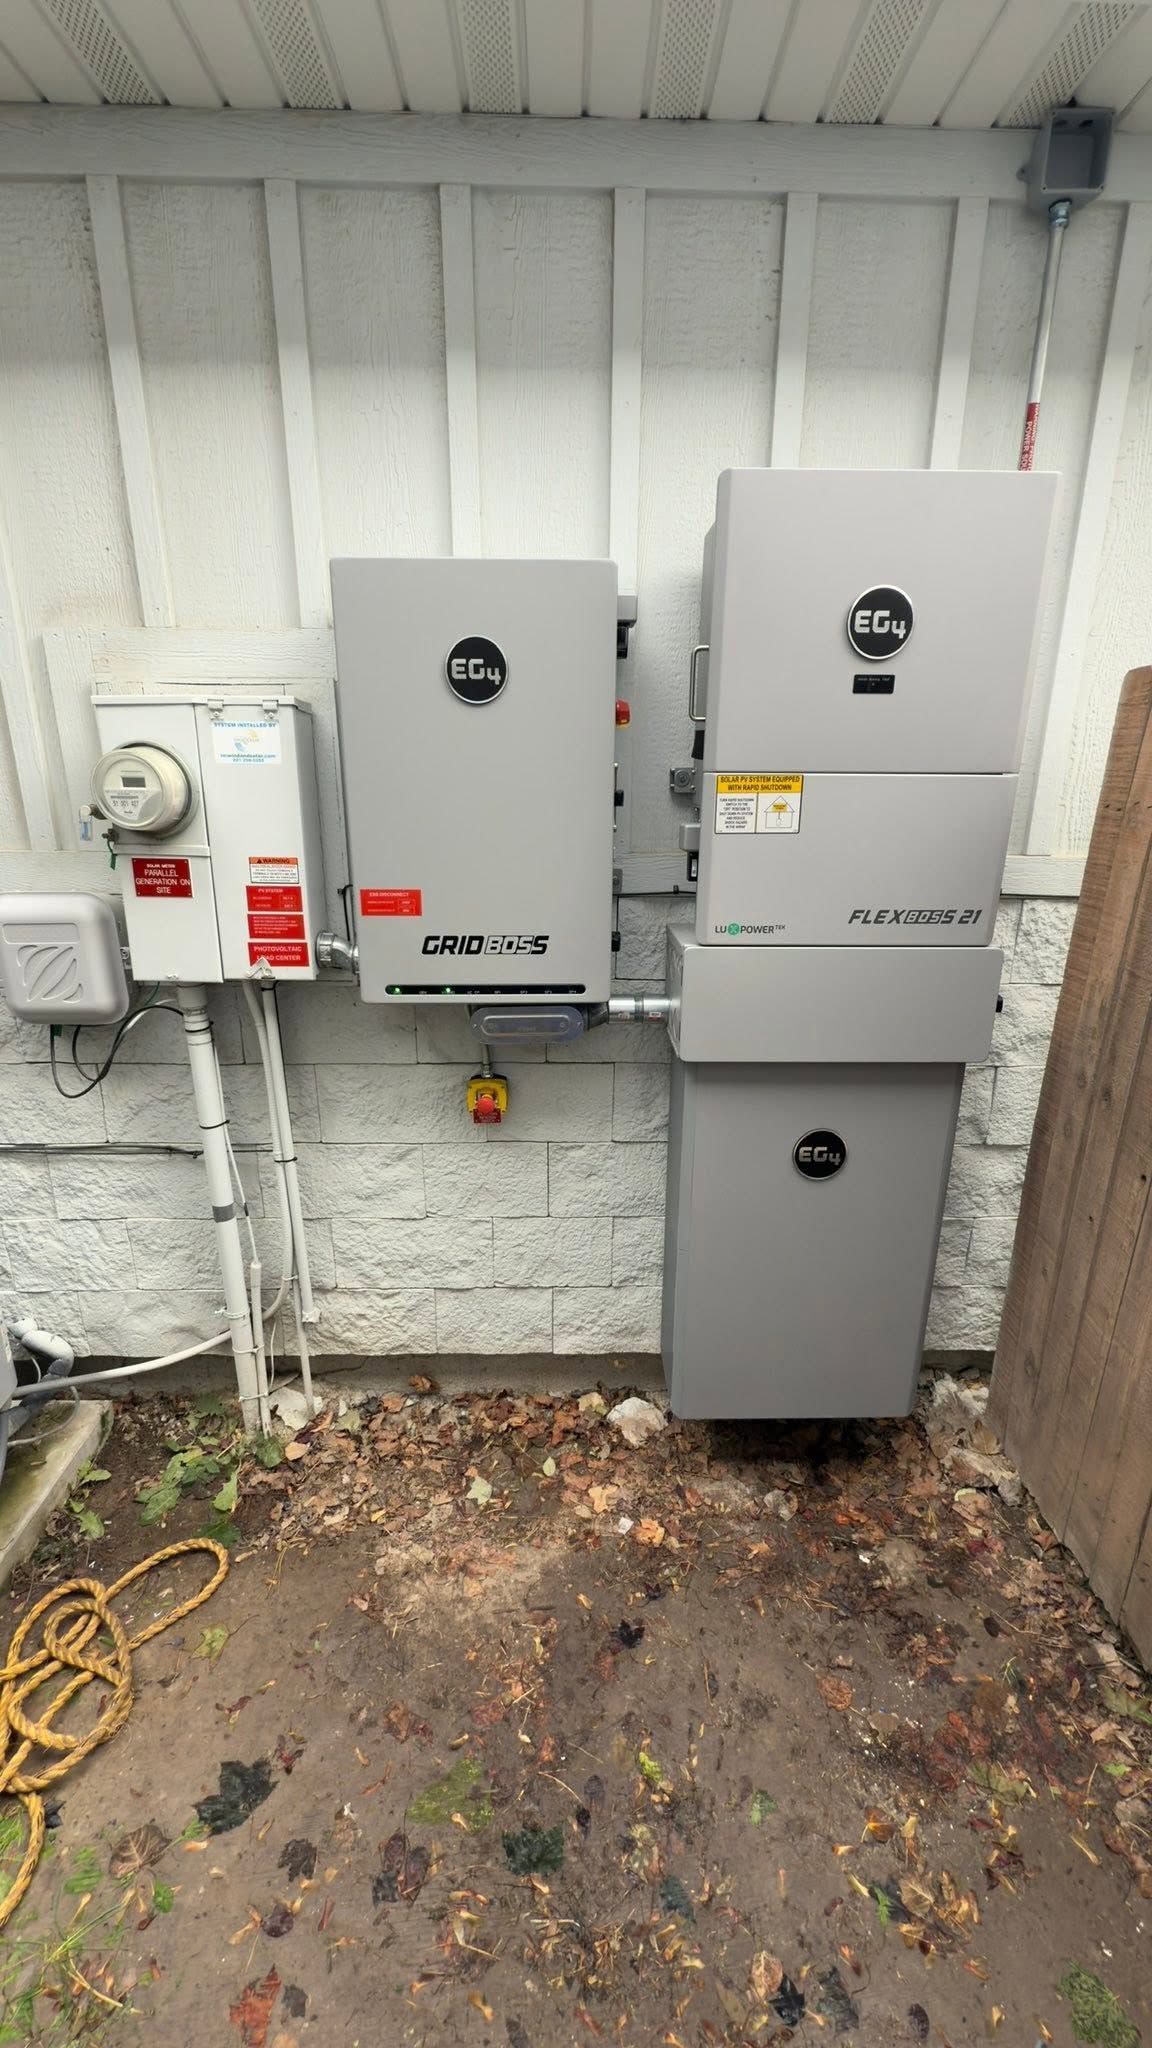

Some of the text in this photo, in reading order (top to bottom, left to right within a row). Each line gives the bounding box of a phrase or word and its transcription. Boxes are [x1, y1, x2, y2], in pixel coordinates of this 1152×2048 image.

[1024, 421, 1032, 452] POWER
[854, 610, 906, 639] EG4
[451, 658, 502, 685] EG4
[958, 910, 982, 924] 21
[422, 936, 550, 955] GRIDBOSS
[799, 1146, 841, 1165] EG4
